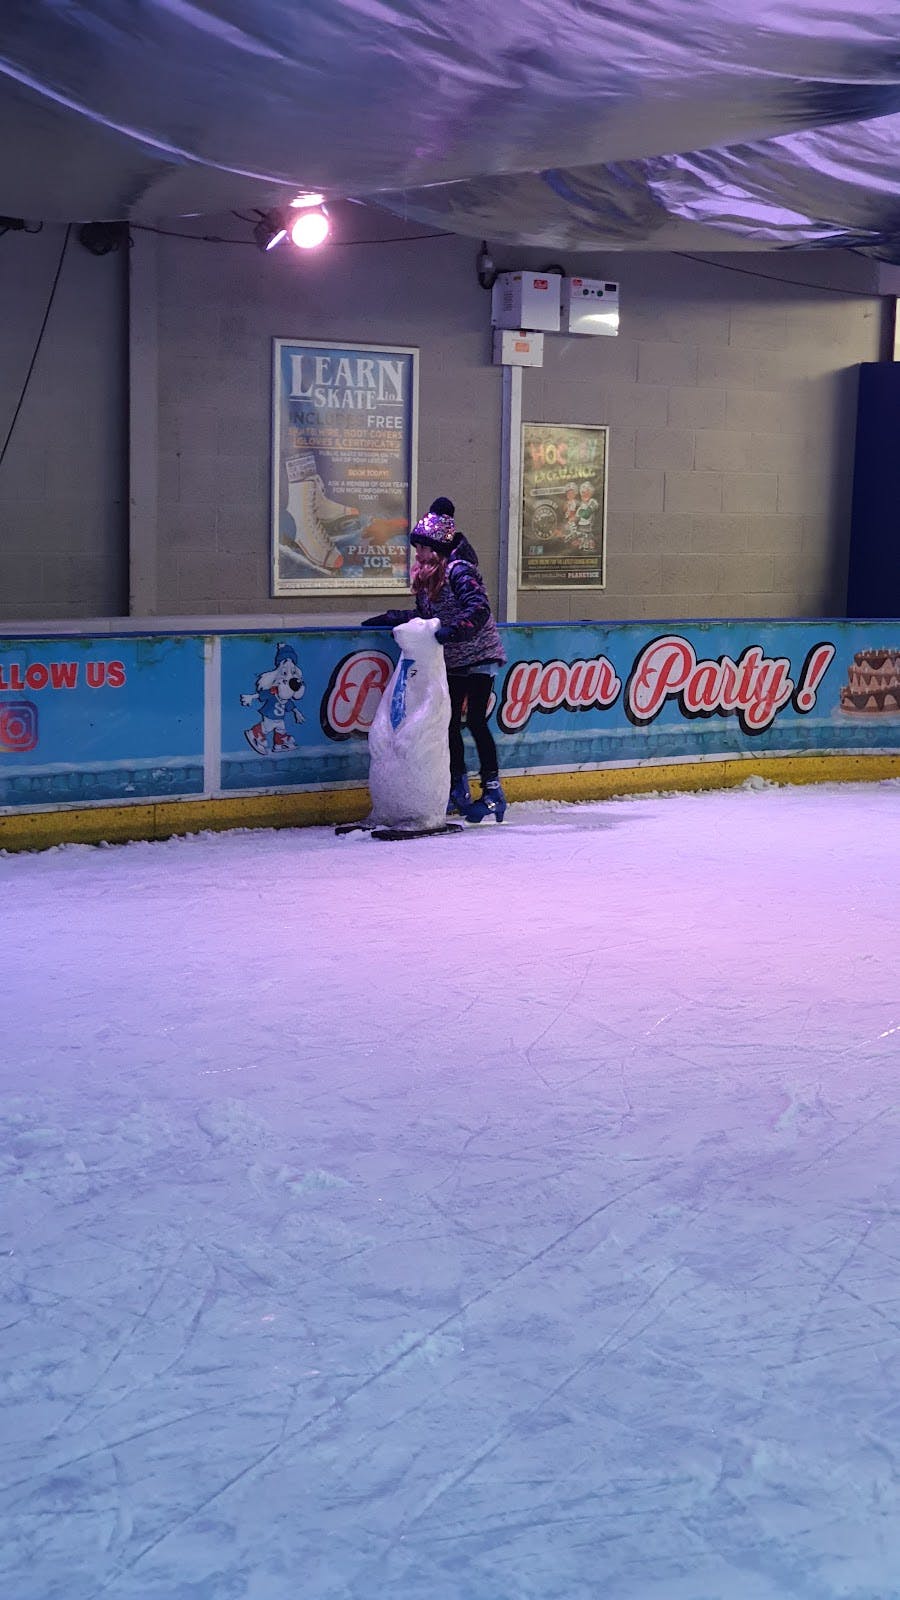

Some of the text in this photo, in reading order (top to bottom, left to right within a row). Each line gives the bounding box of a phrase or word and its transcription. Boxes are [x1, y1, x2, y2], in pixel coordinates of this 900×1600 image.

[289, 354, 404, 401] LEARN
[314, 387, 376, 409] SKATE
[367, 415, 403, 428] FREE
[344, 429, 367, 439] BOOT
[369, 430, 403, 440] COVERS
[342, 439, 400, 449] CERTIFICATES
[348, 545, 407, 556] PLANET
[363, 556, 392, 568] ICE
[86, 661, 126, 688] US
[504, 657, 620, 727] your
[273, 701, 285, 716] S
